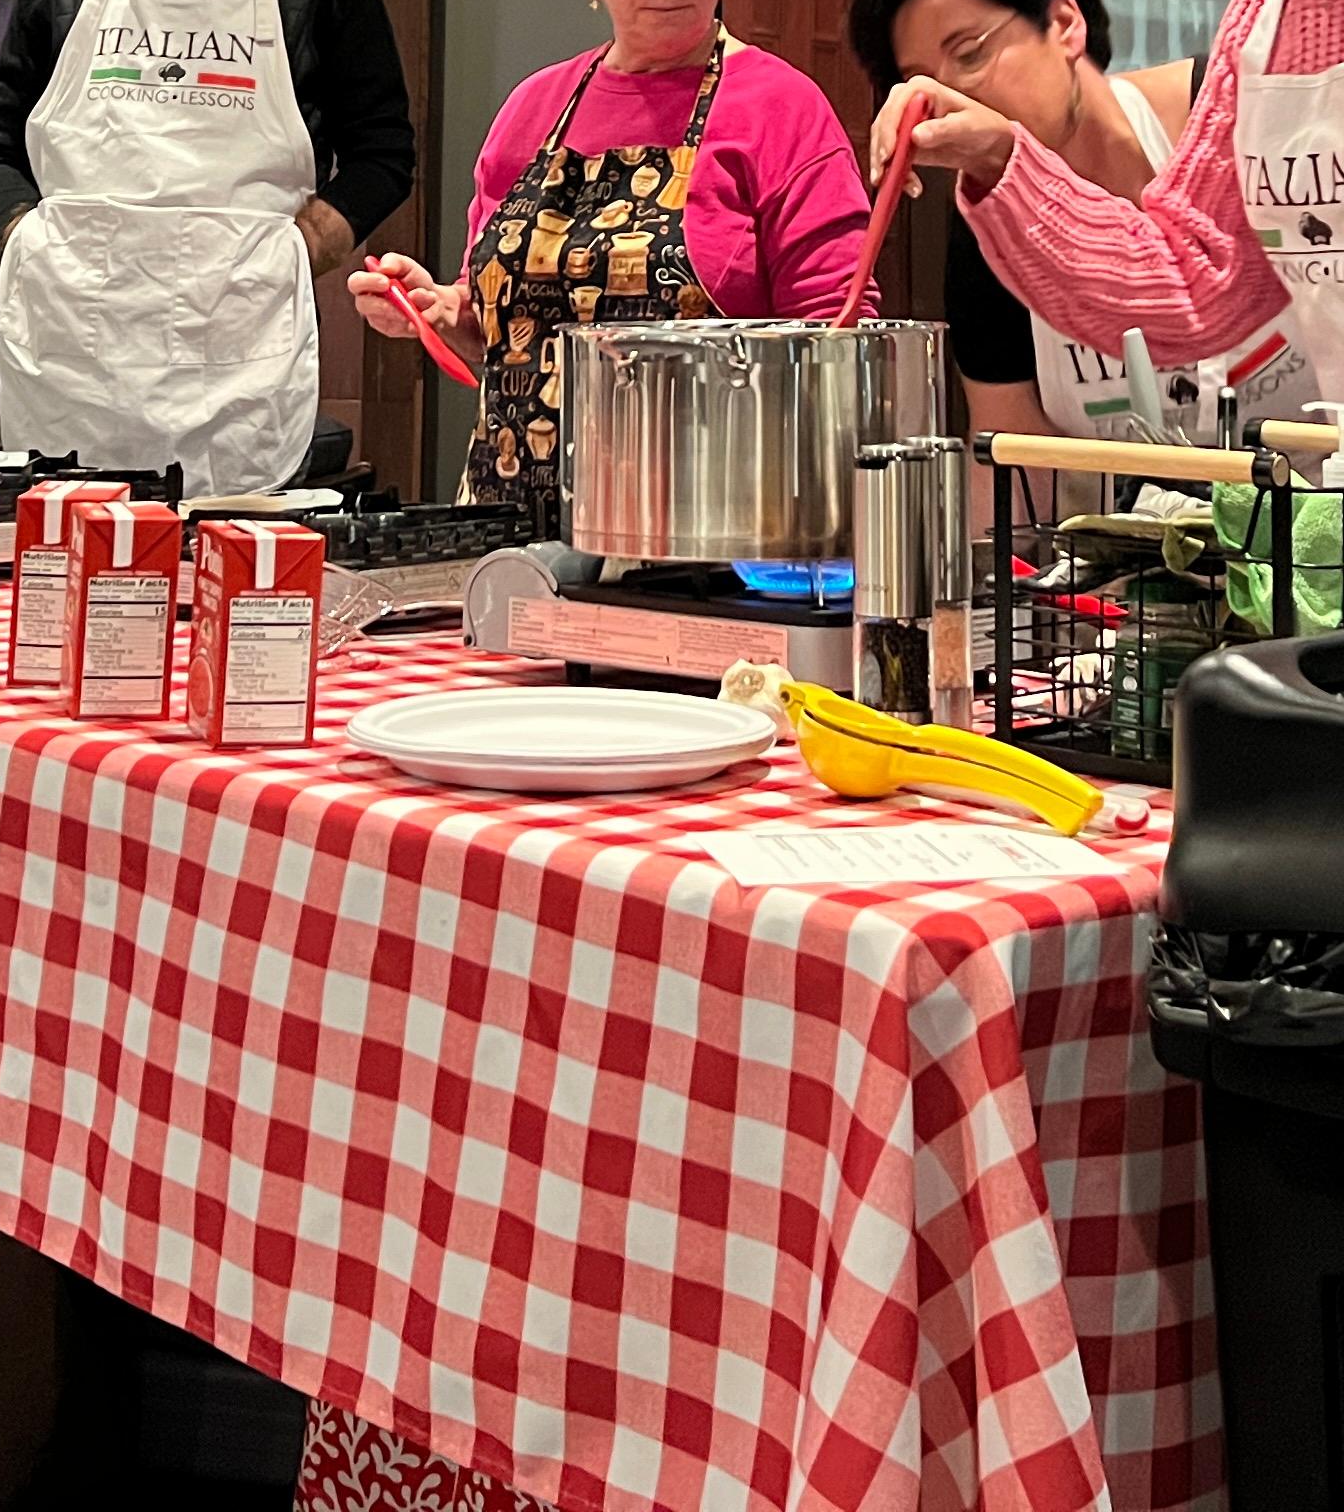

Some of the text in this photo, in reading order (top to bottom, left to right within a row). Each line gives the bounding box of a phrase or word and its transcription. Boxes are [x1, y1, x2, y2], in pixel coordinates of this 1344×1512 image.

[95, 27, 256, 65] ITALIAN
[87, 85, 256, 112] COOKING LESSONS
[501, 370, 539, 397] CUPS
